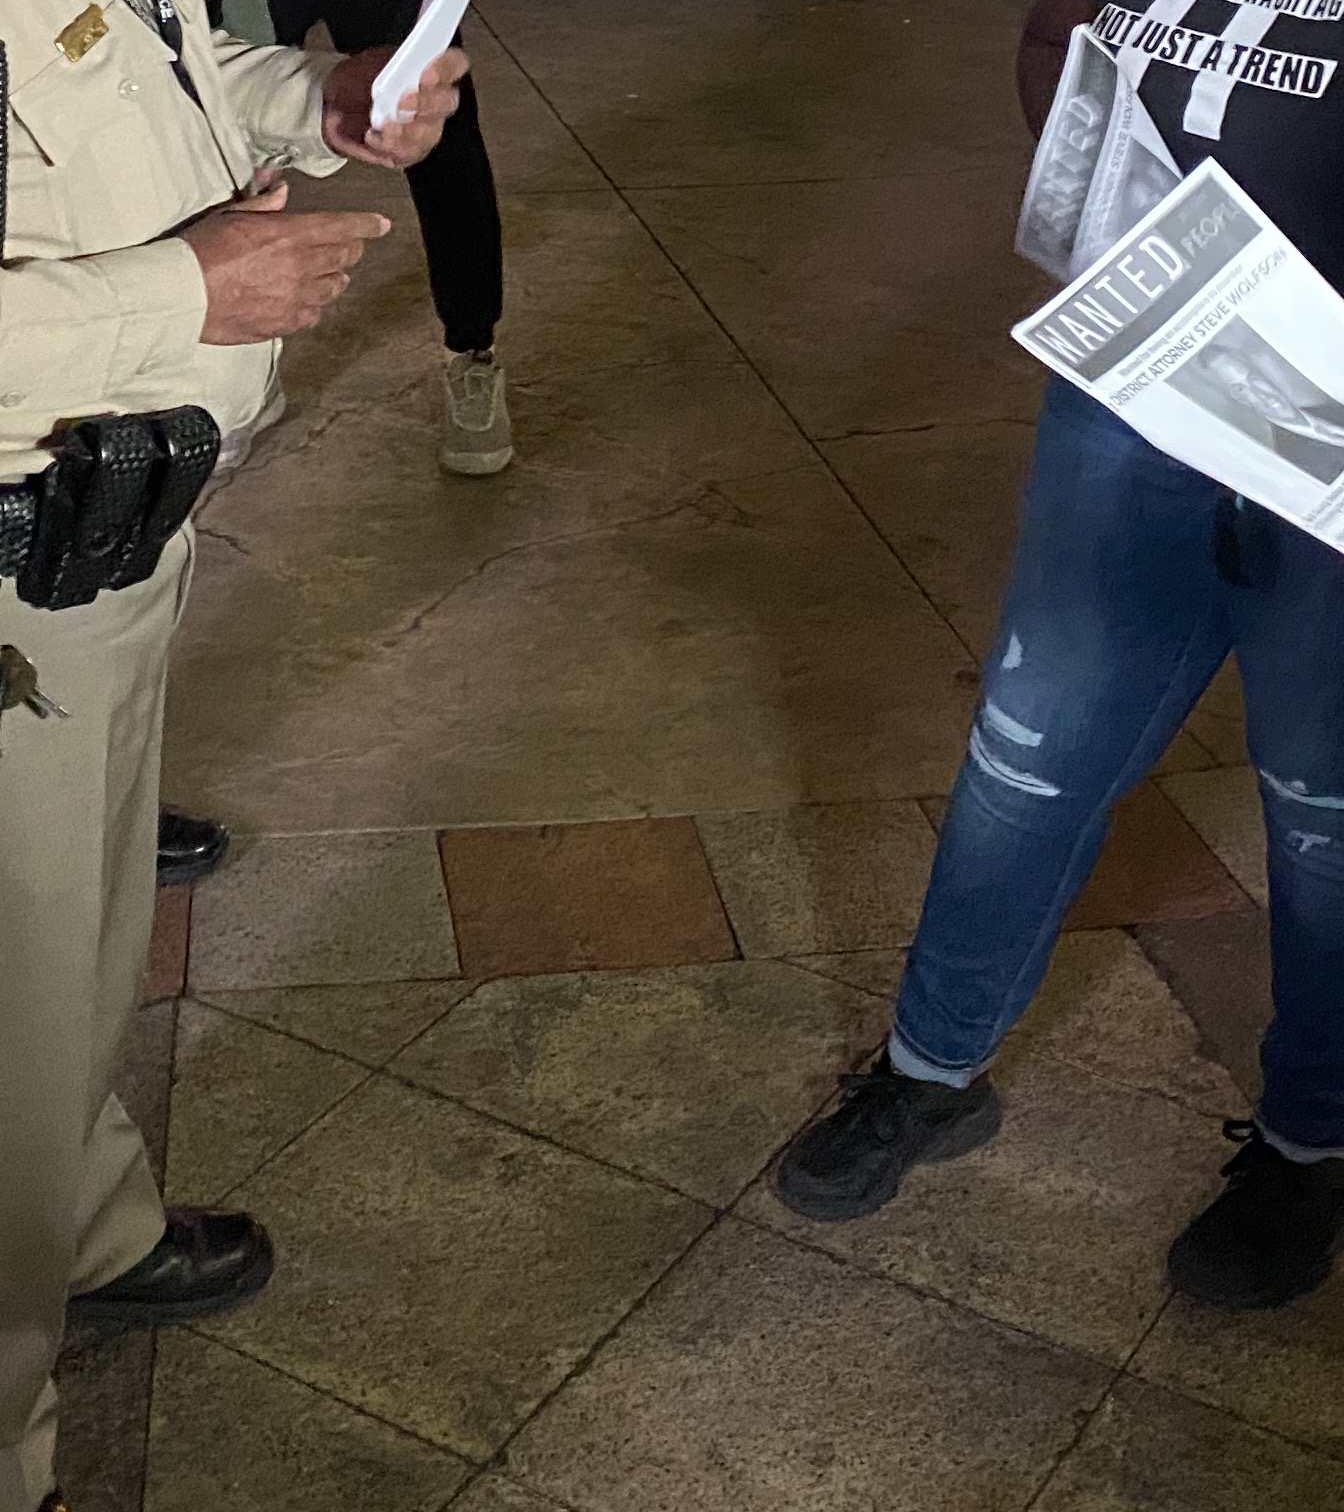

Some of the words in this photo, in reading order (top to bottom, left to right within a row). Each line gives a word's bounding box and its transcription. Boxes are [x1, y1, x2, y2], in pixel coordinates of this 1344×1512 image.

[1093, 5, 1141, 45] NOT
[1132, 18, 1204, 64] JUST
[1200, 39, 1226, 73] A
[1226, 43, 1325, 95] TREND
[1034, 234, 1185, 366] WANTED
[1110, 367, 1155, 409] DISTRICT
[1146, 329, 1199, 379] ATTORNEY
[1192, 299, 1233, 338] STEVE
